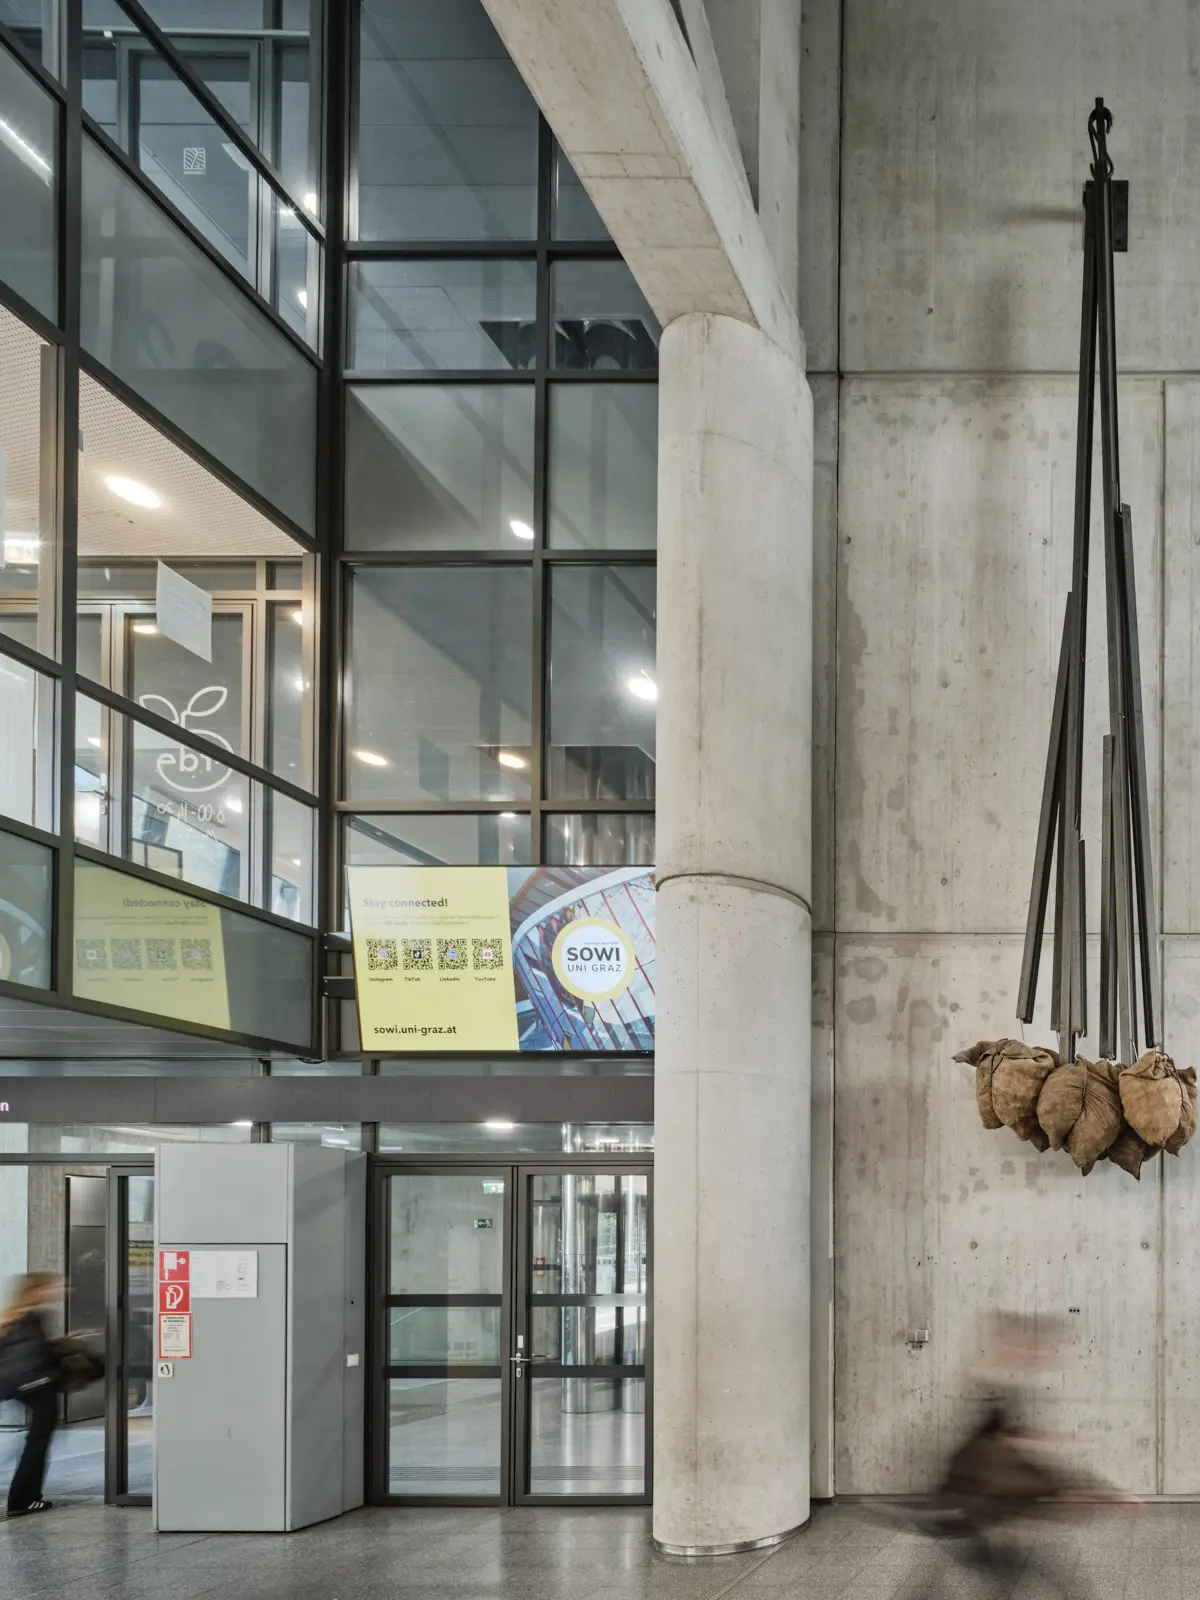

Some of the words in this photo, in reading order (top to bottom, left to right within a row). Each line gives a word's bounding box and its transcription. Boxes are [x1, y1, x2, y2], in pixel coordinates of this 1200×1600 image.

[363, 898, 385, 909] Stay
[389, 897, 448, 907] connected!
[567, 947, 620, 961] SOWI
[567, 964, 587, 972] UNI
[591, 964, 621, 972] GRAZ
[374, 1025, 457, 1036] sowi.uni-graz.at
[0, 1102, 9, 1112] n
